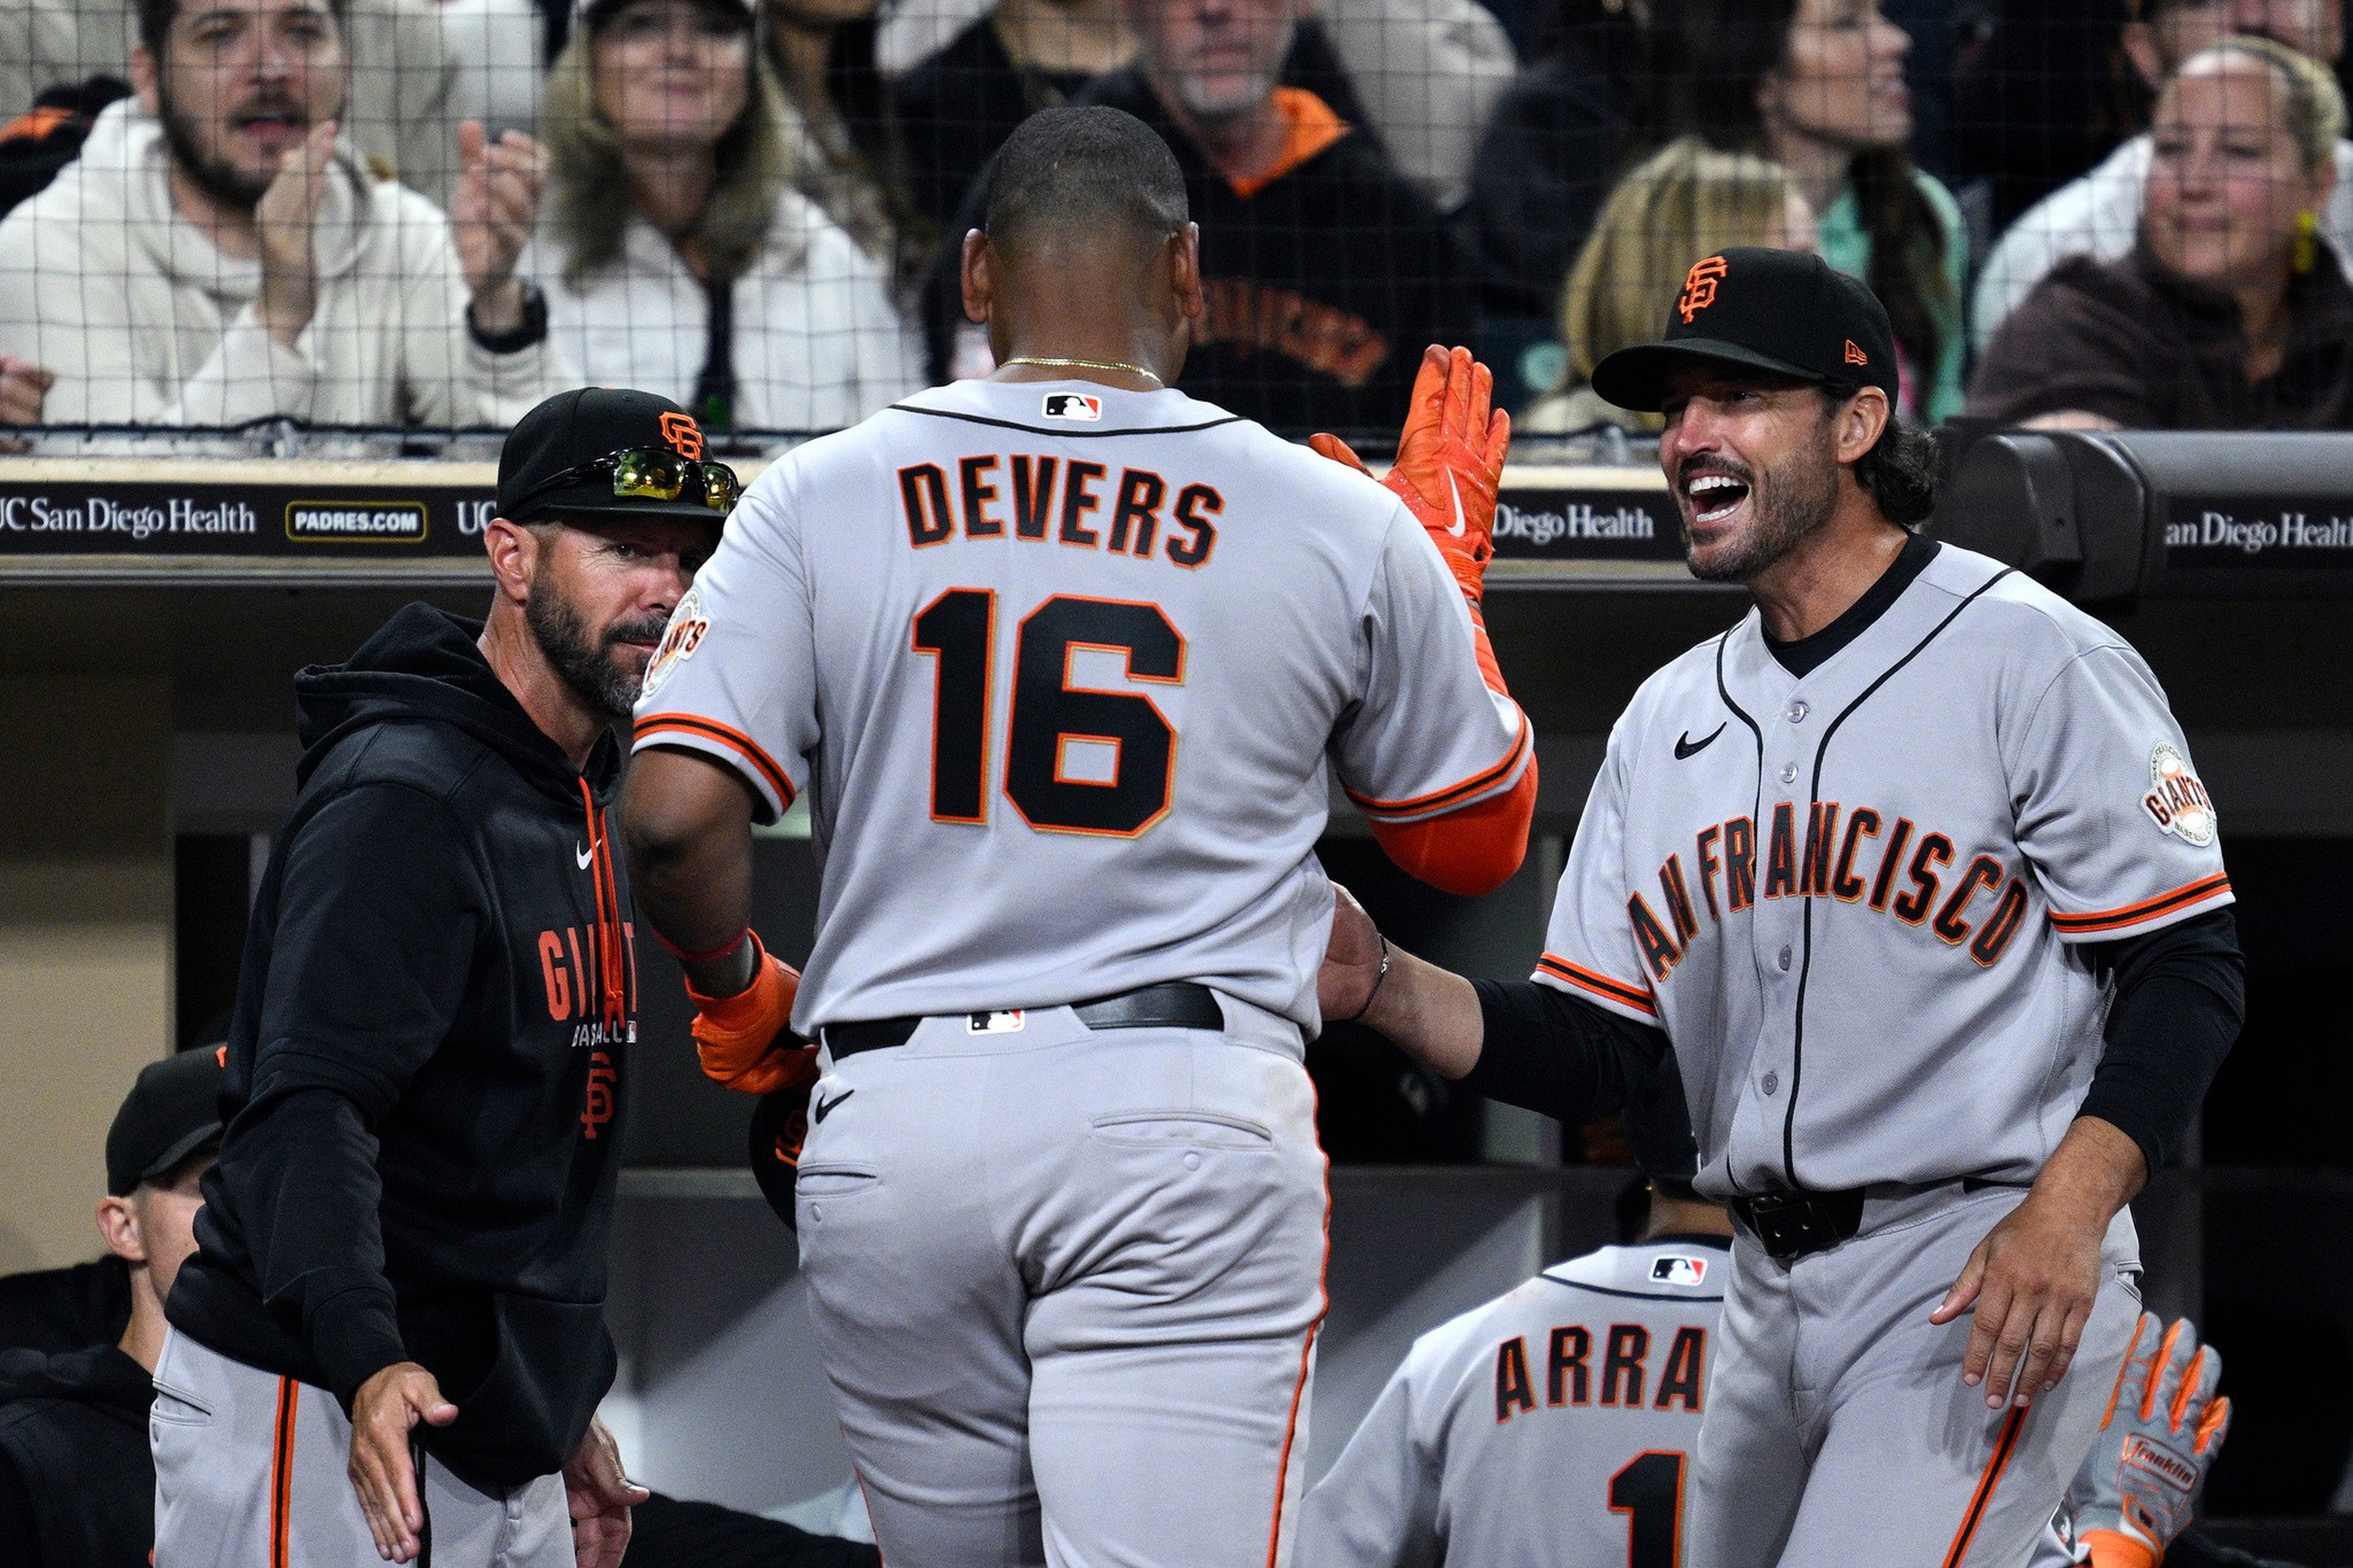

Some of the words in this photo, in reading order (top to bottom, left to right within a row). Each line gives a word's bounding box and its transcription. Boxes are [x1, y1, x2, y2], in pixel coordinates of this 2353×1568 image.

[0, 496, 27, 531] C
[30, 497, 83, 531] San
[87, 498, 165, 539] Diego
[168, 498, 257, 533] Health
[294, 511, 419, 532] PADRES.COM
[897, 453, 1225, 570] DEVERS
[1491, 503, 1565, 545] Diego
[1567, 504, 1654, 538] Health
[2203, 511, 2277, 553] Diego
[911, 586, 1189, 840] 16
[1696, 801, 2029, 969] FRANCISCO
[1495, 1322, 1707, 1425] ARRA
[2128, 1440, 2192, 1483] Franklin
